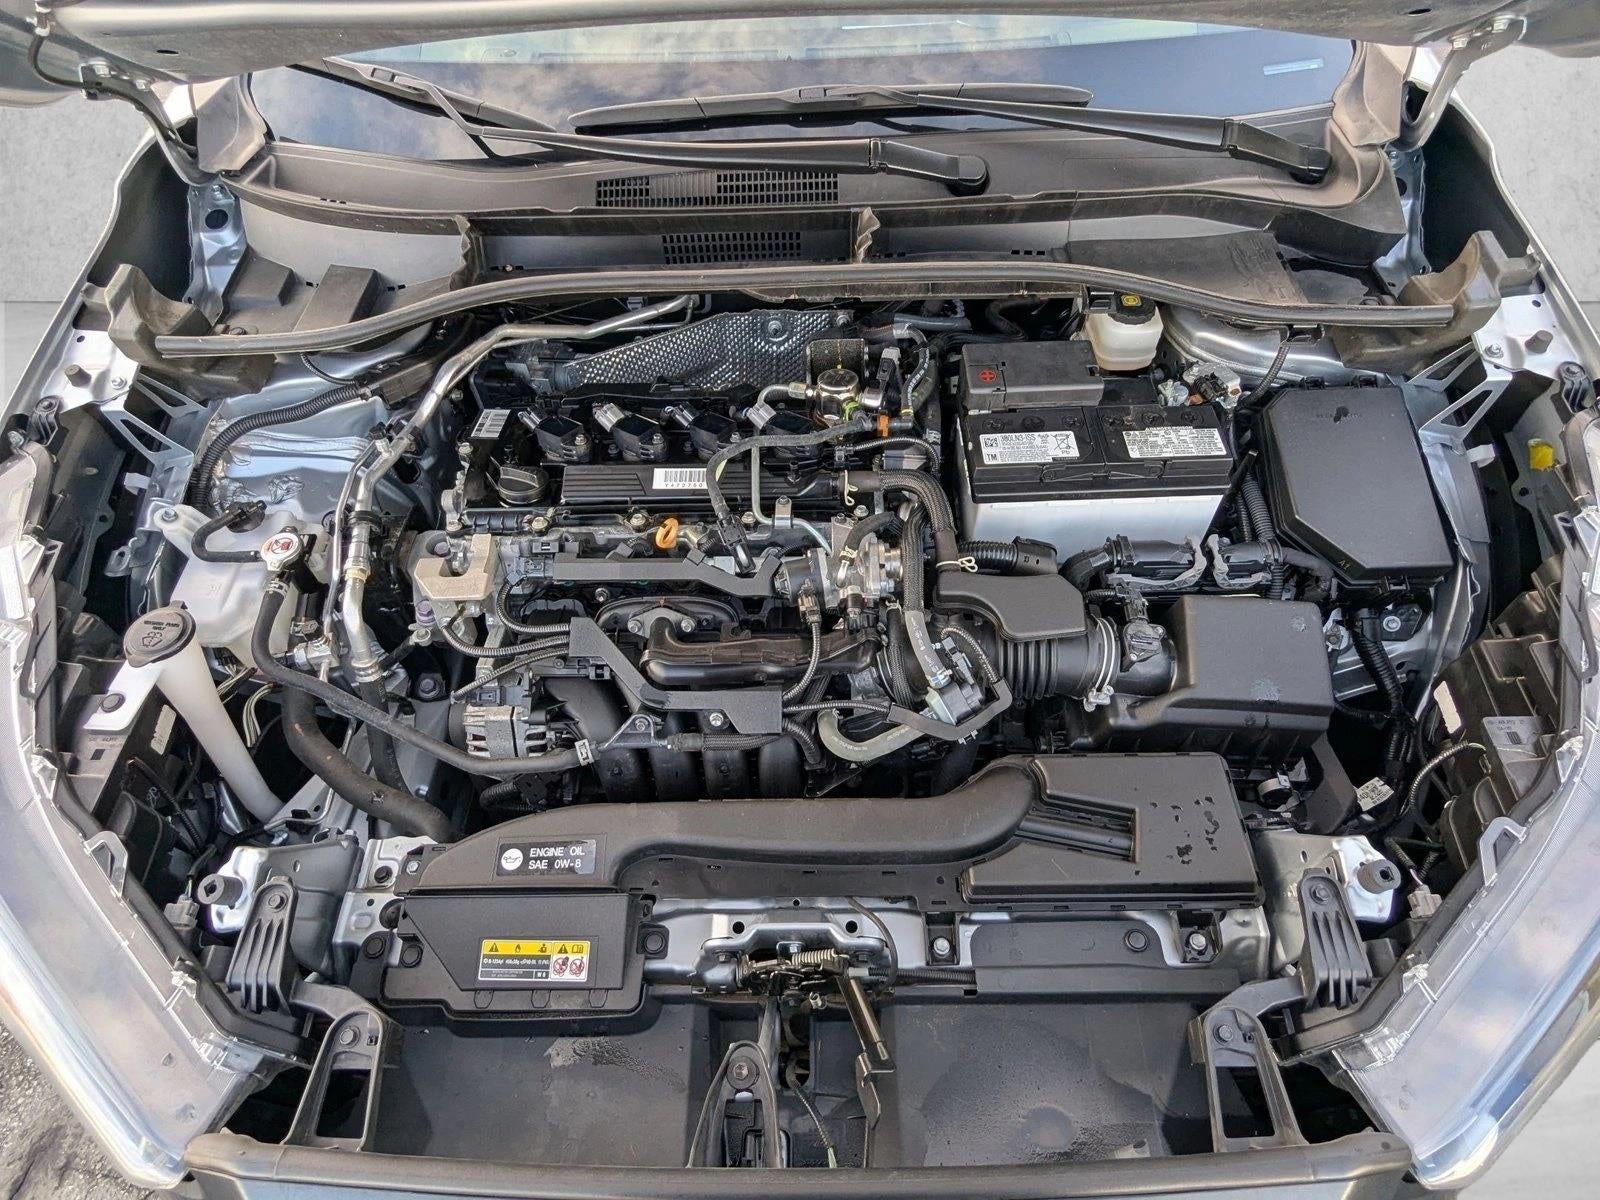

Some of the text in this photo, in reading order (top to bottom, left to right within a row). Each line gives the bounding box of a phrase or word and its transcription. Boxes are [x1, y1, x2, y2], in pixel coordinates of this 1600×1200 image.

[986, 453, 998, 461] TM
[529, 846, 585, 857] ENGINE OIL
[528, 859, 581, 870] SAE 0W-8
